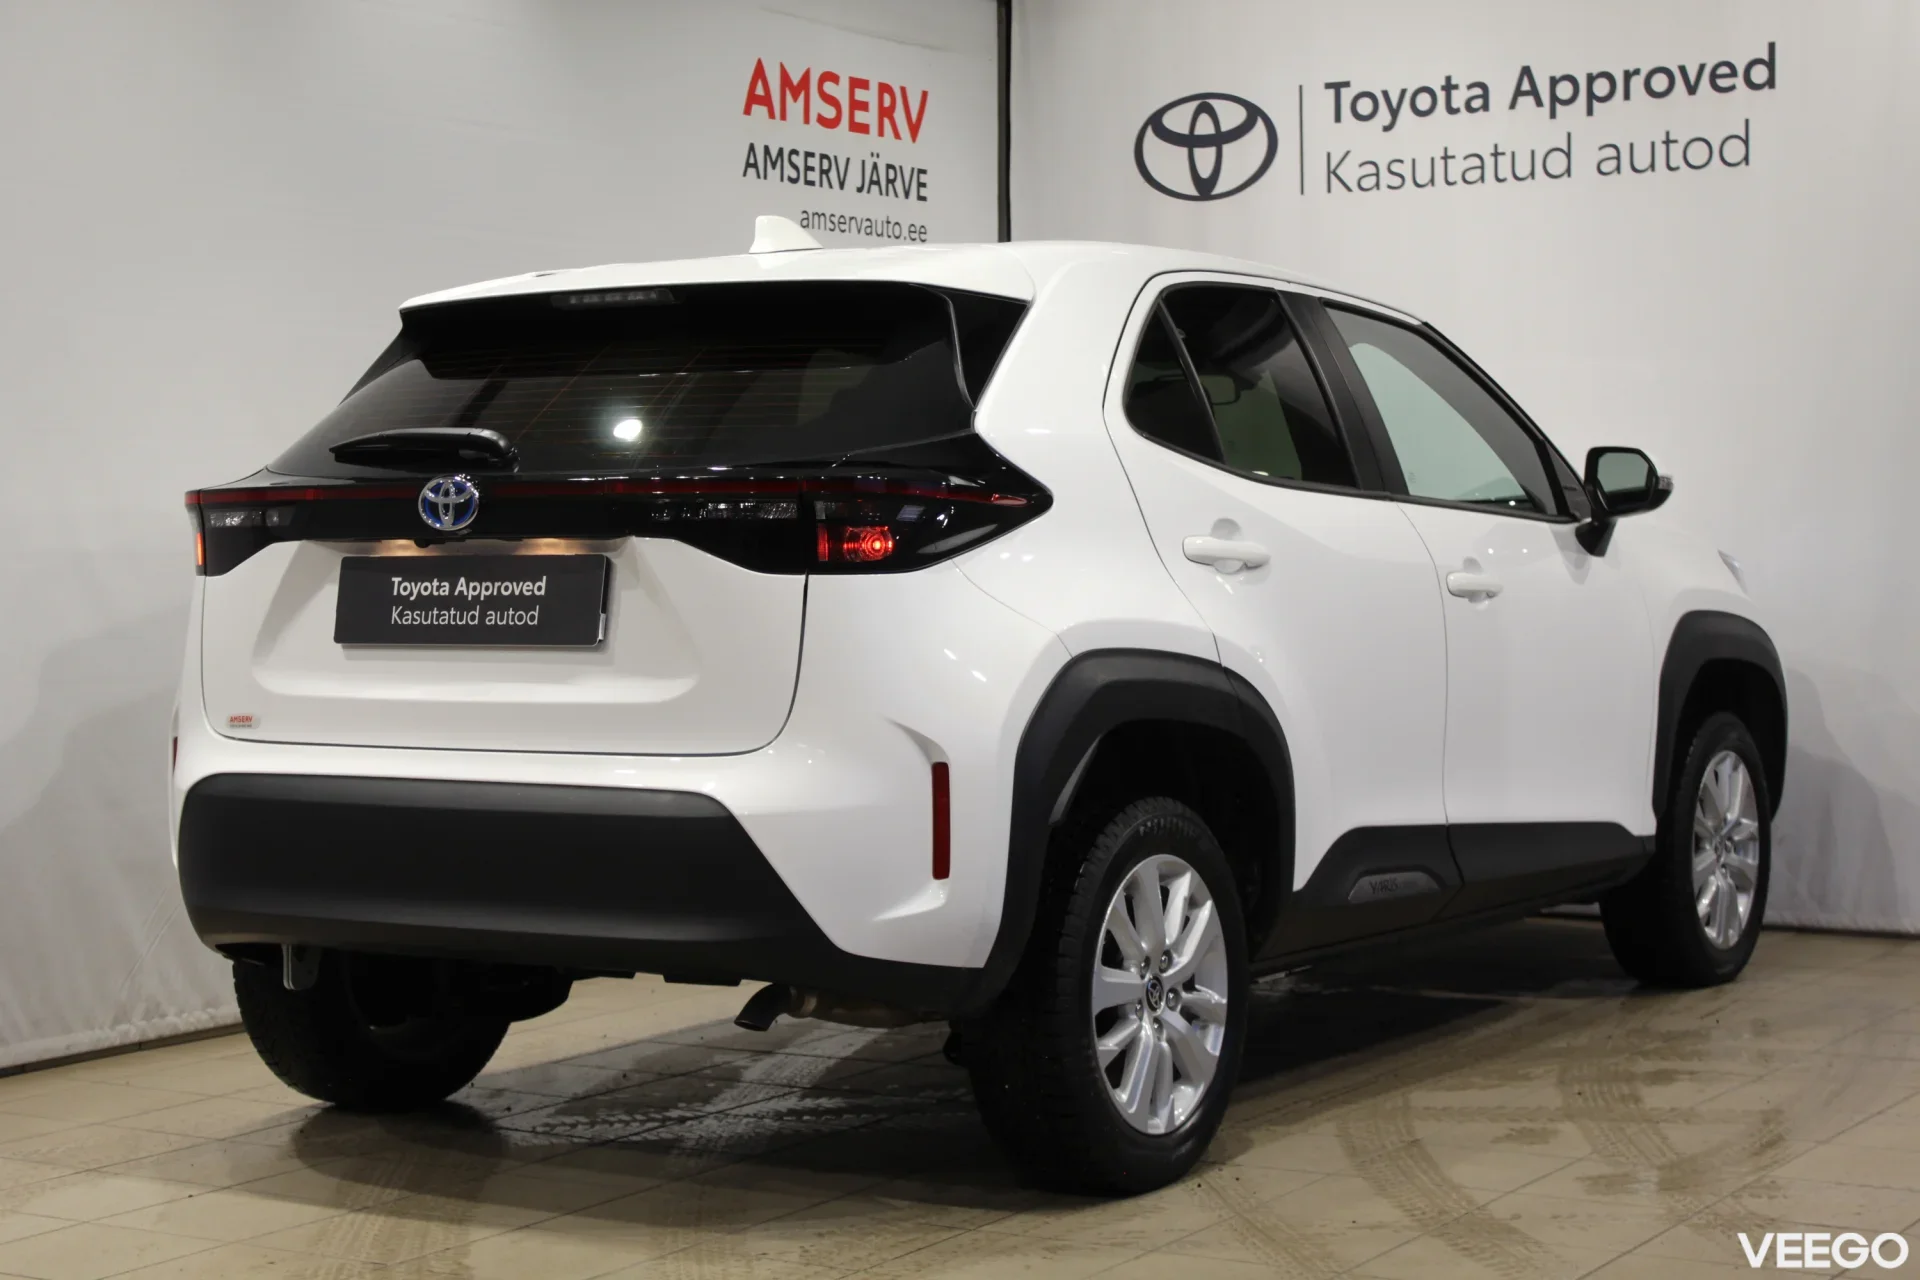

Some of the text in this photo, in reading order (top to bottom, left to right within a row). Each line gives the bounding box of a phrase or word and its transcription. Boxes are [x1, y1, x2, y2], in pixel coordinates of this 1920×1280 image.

[743, 57, 929, 143] AMSERV
[1324, 41, 1777, 132] Toyota Approved
[742, 142, 928, 202] AMSERV JÄRVE
[1326, 118, 1751, 194] Kasutatud autod
[800, 209, 928, 243] amservauto.ee
[391, 575, 547, 601] Toyota Approved
[391, 605, 540, 626] Kasutatud autod
[229, 715, 253, 723] AMSERV
